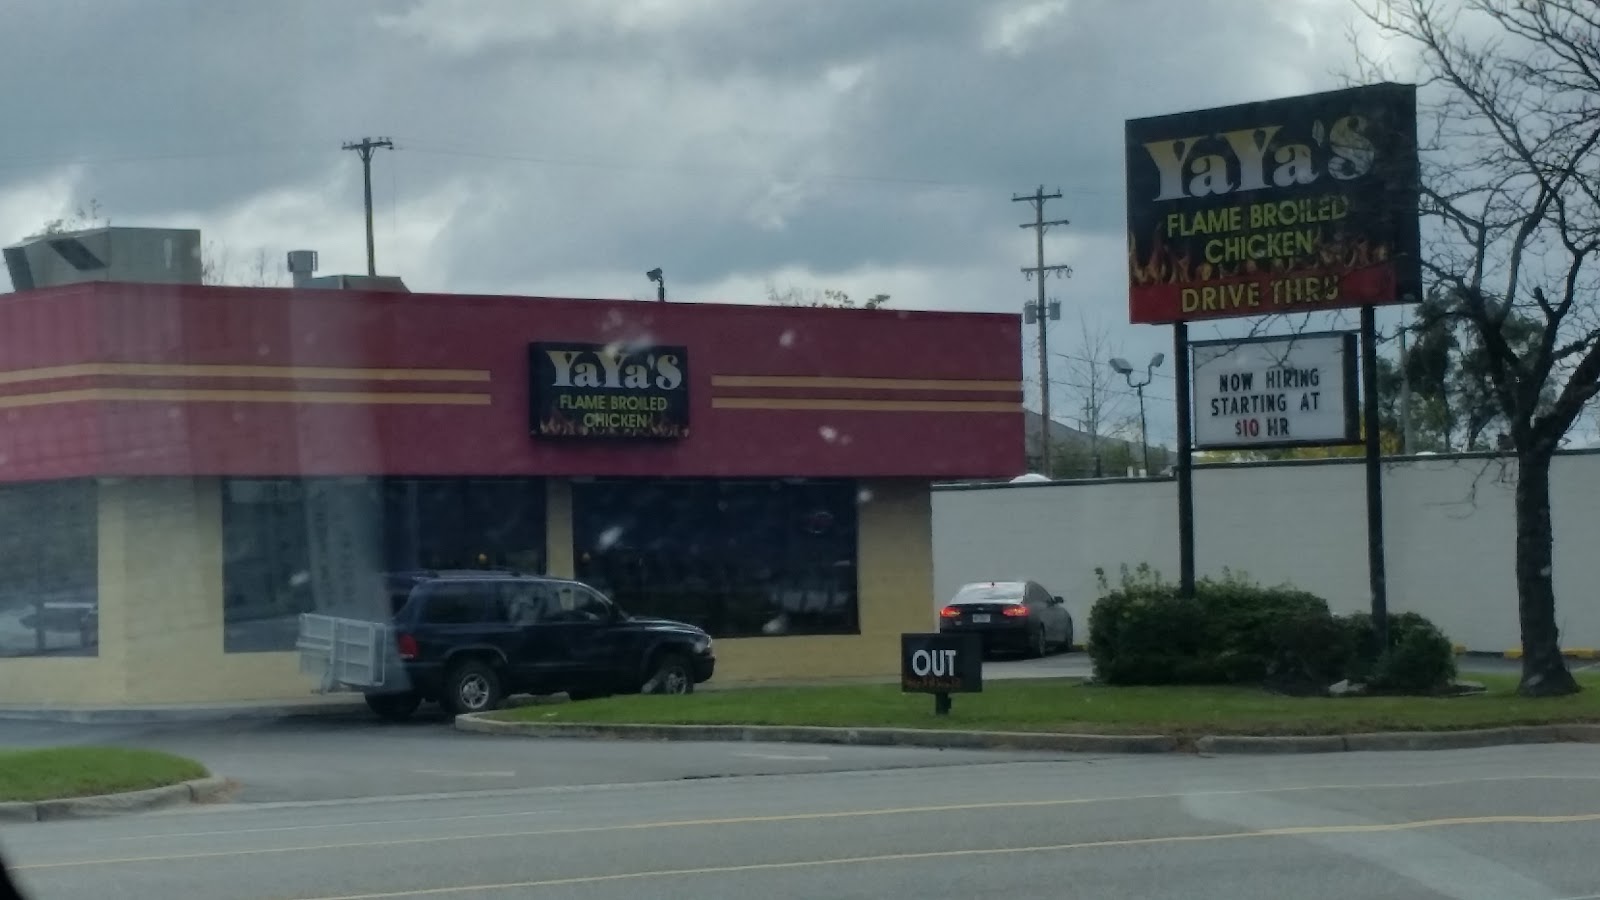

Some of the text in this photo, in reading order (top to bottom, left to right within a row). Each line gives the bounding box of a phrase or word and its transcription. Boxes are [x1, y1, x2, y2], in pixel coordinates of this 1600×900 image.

[1167, 195, 1348, 238] FLAME BROILED
[1205, 229, 1315, 264] CHICKEN
[1181, 275, 1339, 313] DRIVE THRU
[1219, 368, 1320, 392] NOW HIRING
[560, 395, 668, 411] FLAME BROILED
[1211, 392, 1320, 416] STARTING AT
[583, 413, 648, 428] CHICKEN
[1235, 417, 1290, 437] $10 HR
[912, 649, 957, 677] OUT
